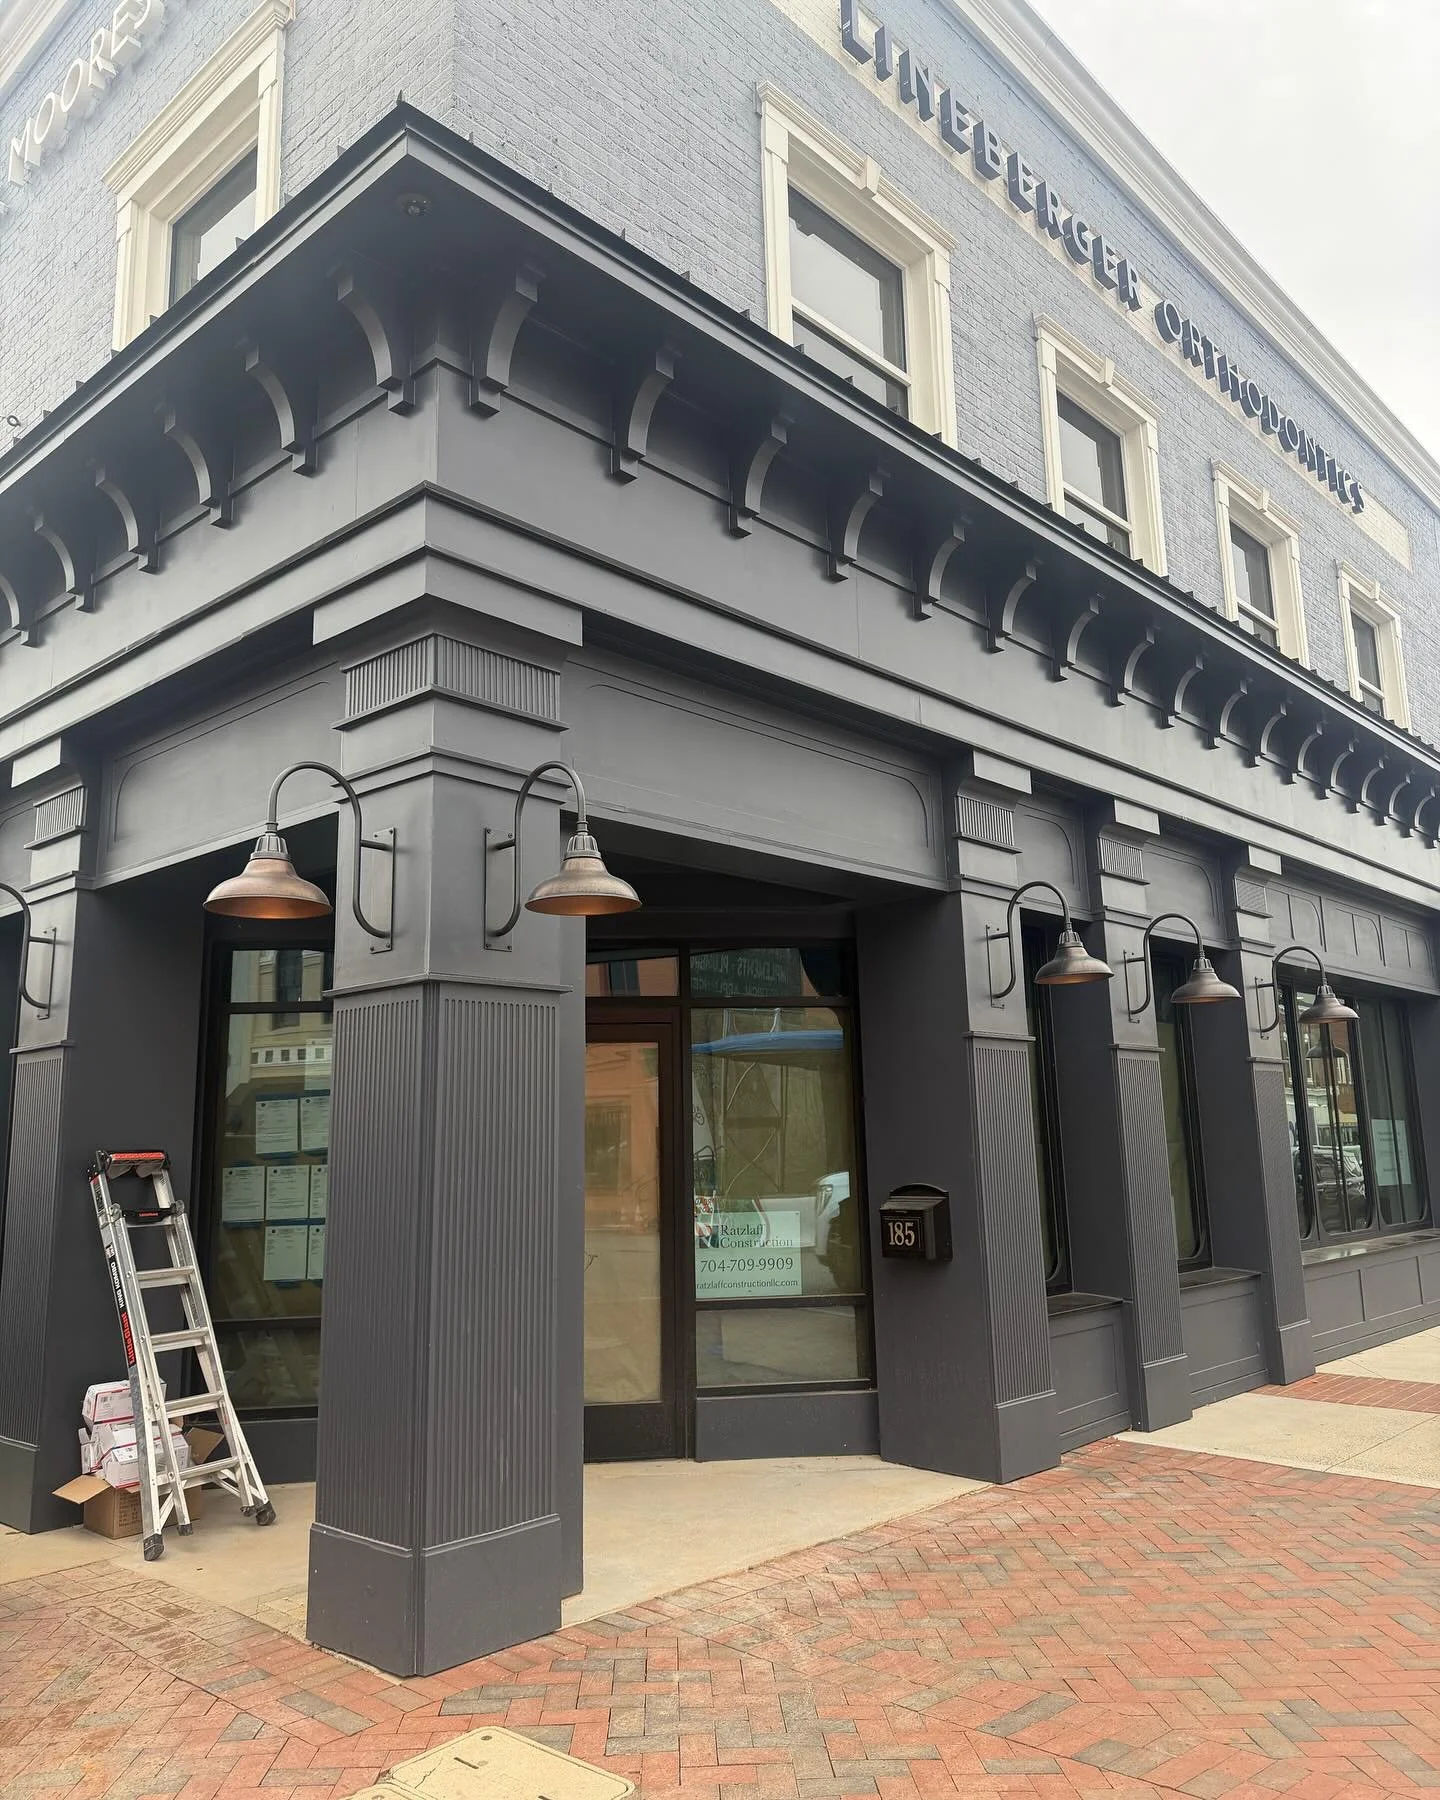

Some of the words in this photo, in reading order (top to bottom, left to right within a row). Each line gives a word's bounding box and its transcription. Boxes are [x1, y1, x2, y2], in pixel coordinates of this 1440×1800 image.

[840, 0, 1142, 311] LINEBERGER
[1154, 300, 1365, 515] ORTHODONTICS
[720, 1237, 793, 1249] Construction
[887, 1221, 916, 1247] 185
[110, 1261, 121, 1290] KOMBO
[700, 1257, 794, 1273] 704-709-9909
[696, 1278, 799, 1290] ratzlaffconstructionllc.com
[116, 1288, 125, 1309] KING
